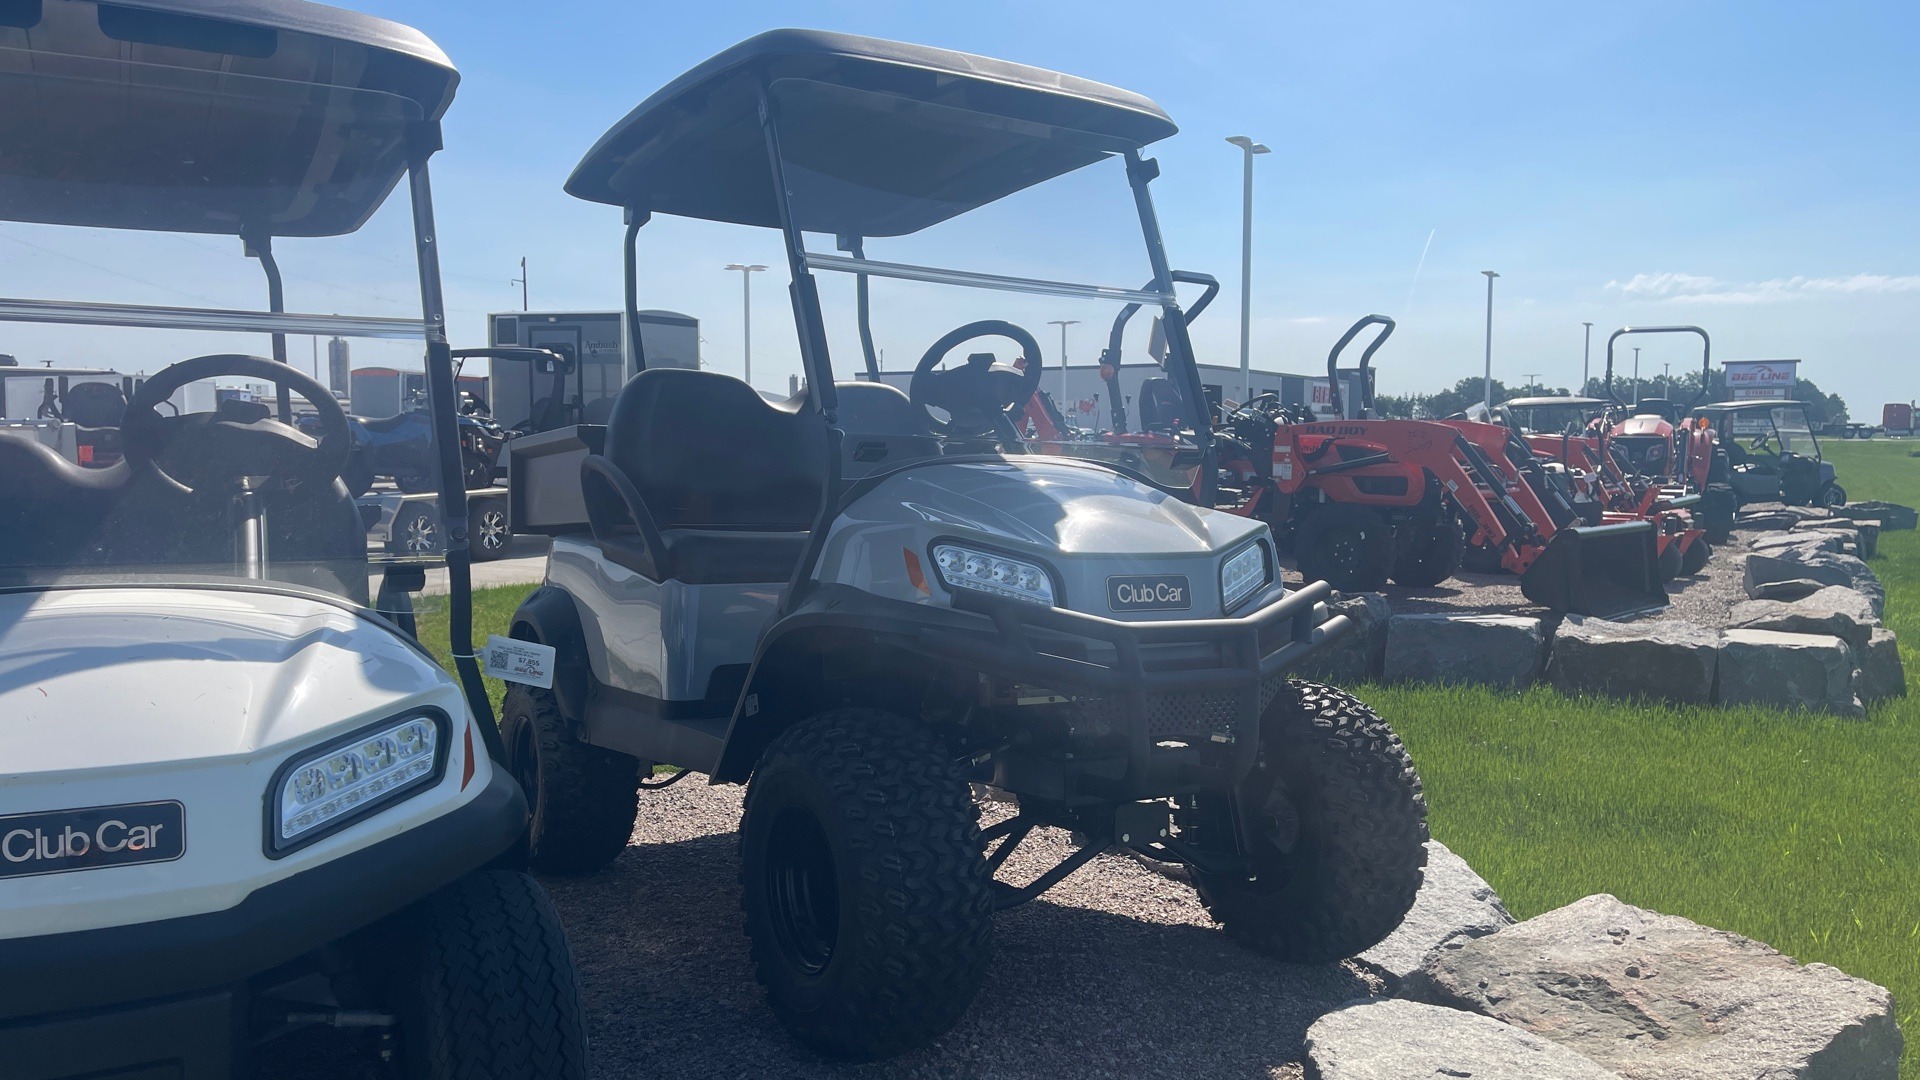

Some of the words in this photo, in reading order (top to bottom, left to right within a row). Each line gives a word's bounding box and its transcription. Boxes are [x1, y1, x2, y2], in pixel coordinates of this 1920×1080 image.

[584, 340, 618, 350] Ambush
[1731, 373, 1757, 381] BEE
[1760, 372, 1790, 381] LINE
[1306, 426, 1335, 434] BAD
[1338, 426, 1368, 435] BOY
[1117, 583, 1154, 603] Club
[1155, 582, 1183, 602] Car
[2, 825, 91, 863] Club
[95, 819, 164, 853] Car
